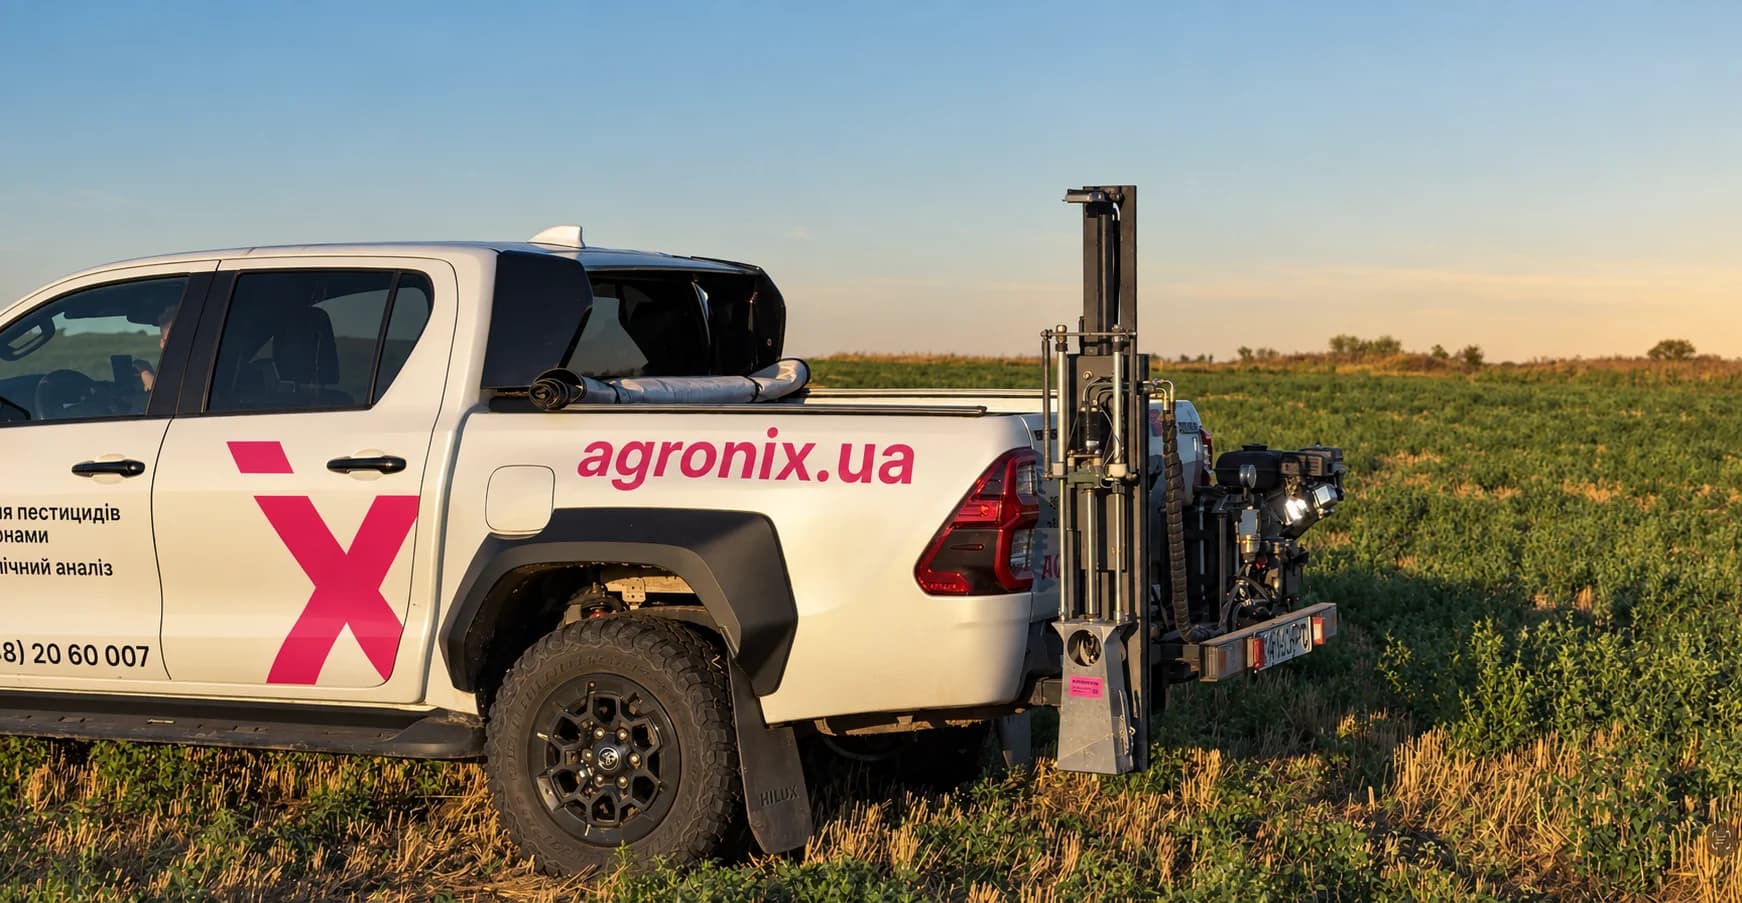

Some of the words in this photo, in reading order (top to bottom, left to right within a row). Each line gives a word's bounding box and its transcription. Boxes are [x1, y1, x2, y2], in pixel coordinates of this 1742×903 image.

[577, 427, 915, 491] agronix.ua
[0, 506, 13, 520] я
[18, 502, 121, 524] пестицидів
[0, 556, 51, 576] ічний
[56, 559, 114, 577] аналіз
[0, 639, 25, 665] 8)
[31, 642, 62, 665] 20
[68, 643, 99, 666] 60
[104, 645, 150, 668] 007
[760, 784, 799, 807] HILUX
